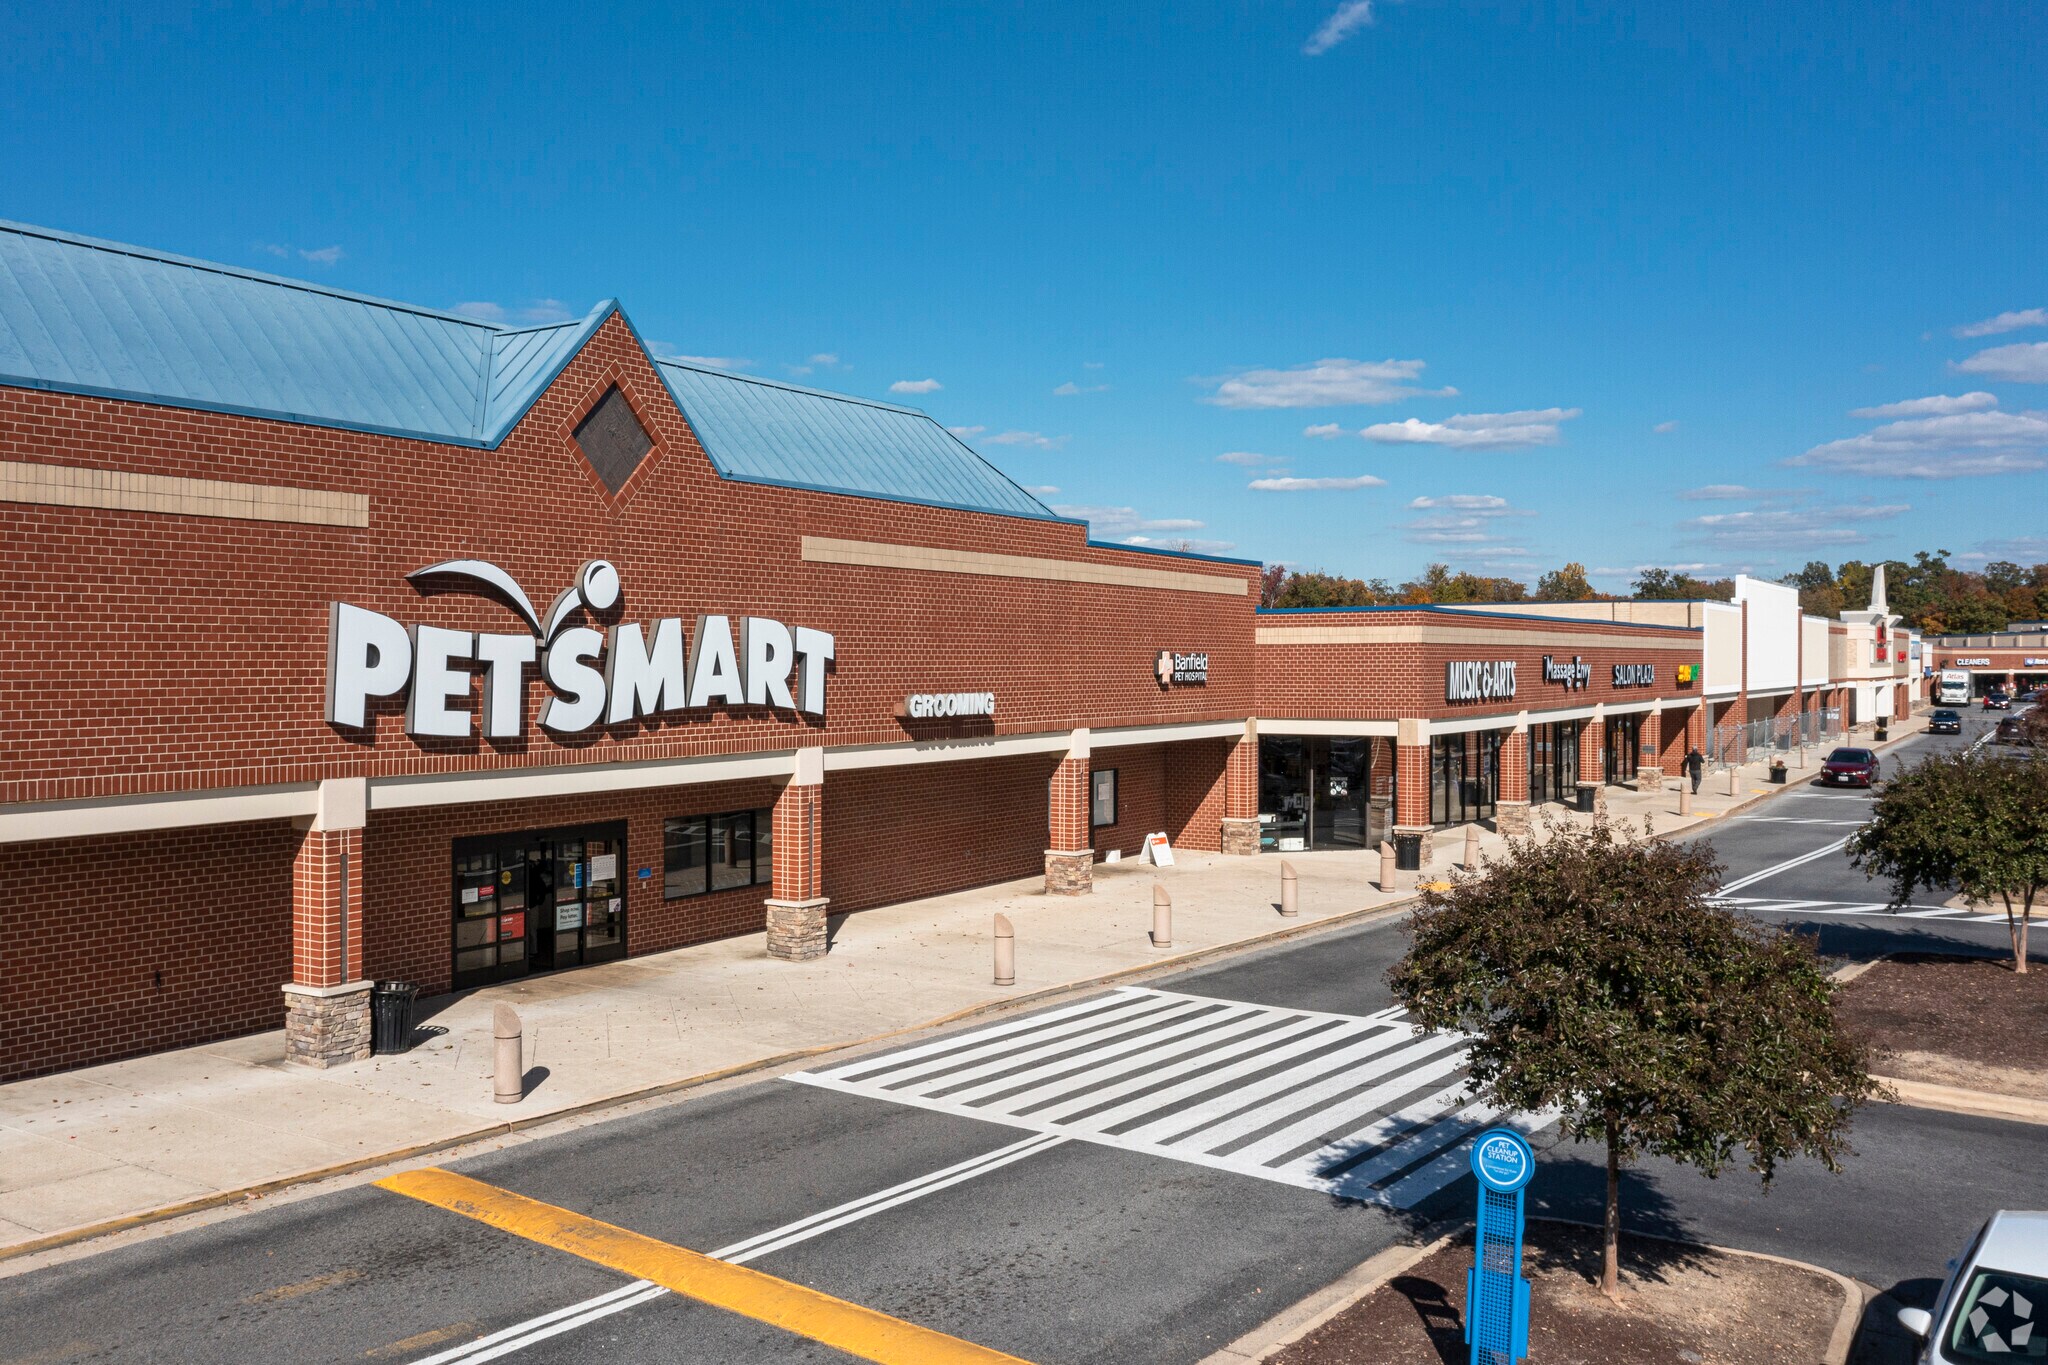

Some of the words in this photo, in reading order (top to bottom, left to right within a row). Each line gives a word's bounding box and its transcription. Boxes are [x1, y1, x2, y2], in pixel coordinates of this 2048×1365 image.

[329, 601, 835, 738] PETSMART
[1175, 653, 1209, 671] Banfield
[1956, 658, 1990, 666] CLEANERS
[1175, 671, 1184, 682] PET
[1184, 671, 1208, 682] HOSPITAL
[1449, 660, 1482, 700] MUSIC
[1482, 660, 1493, 698] &
[1492, 660, 1517, 697] ARTS
[1545, 655, 1576, 688] Massage
[1576, 656, 1592, 688] Envy
[1615, 664, 1636, 685] SALON
[1636, 664, 1655, 684] PLAZA
[909, 692, 995, 718] GROOMING
[1487, 1146, 1519, 1157] CLEANUP
[1498, 1141, 1510, 1149] PET
[1487, 1152, 1518, 1164] STATION
